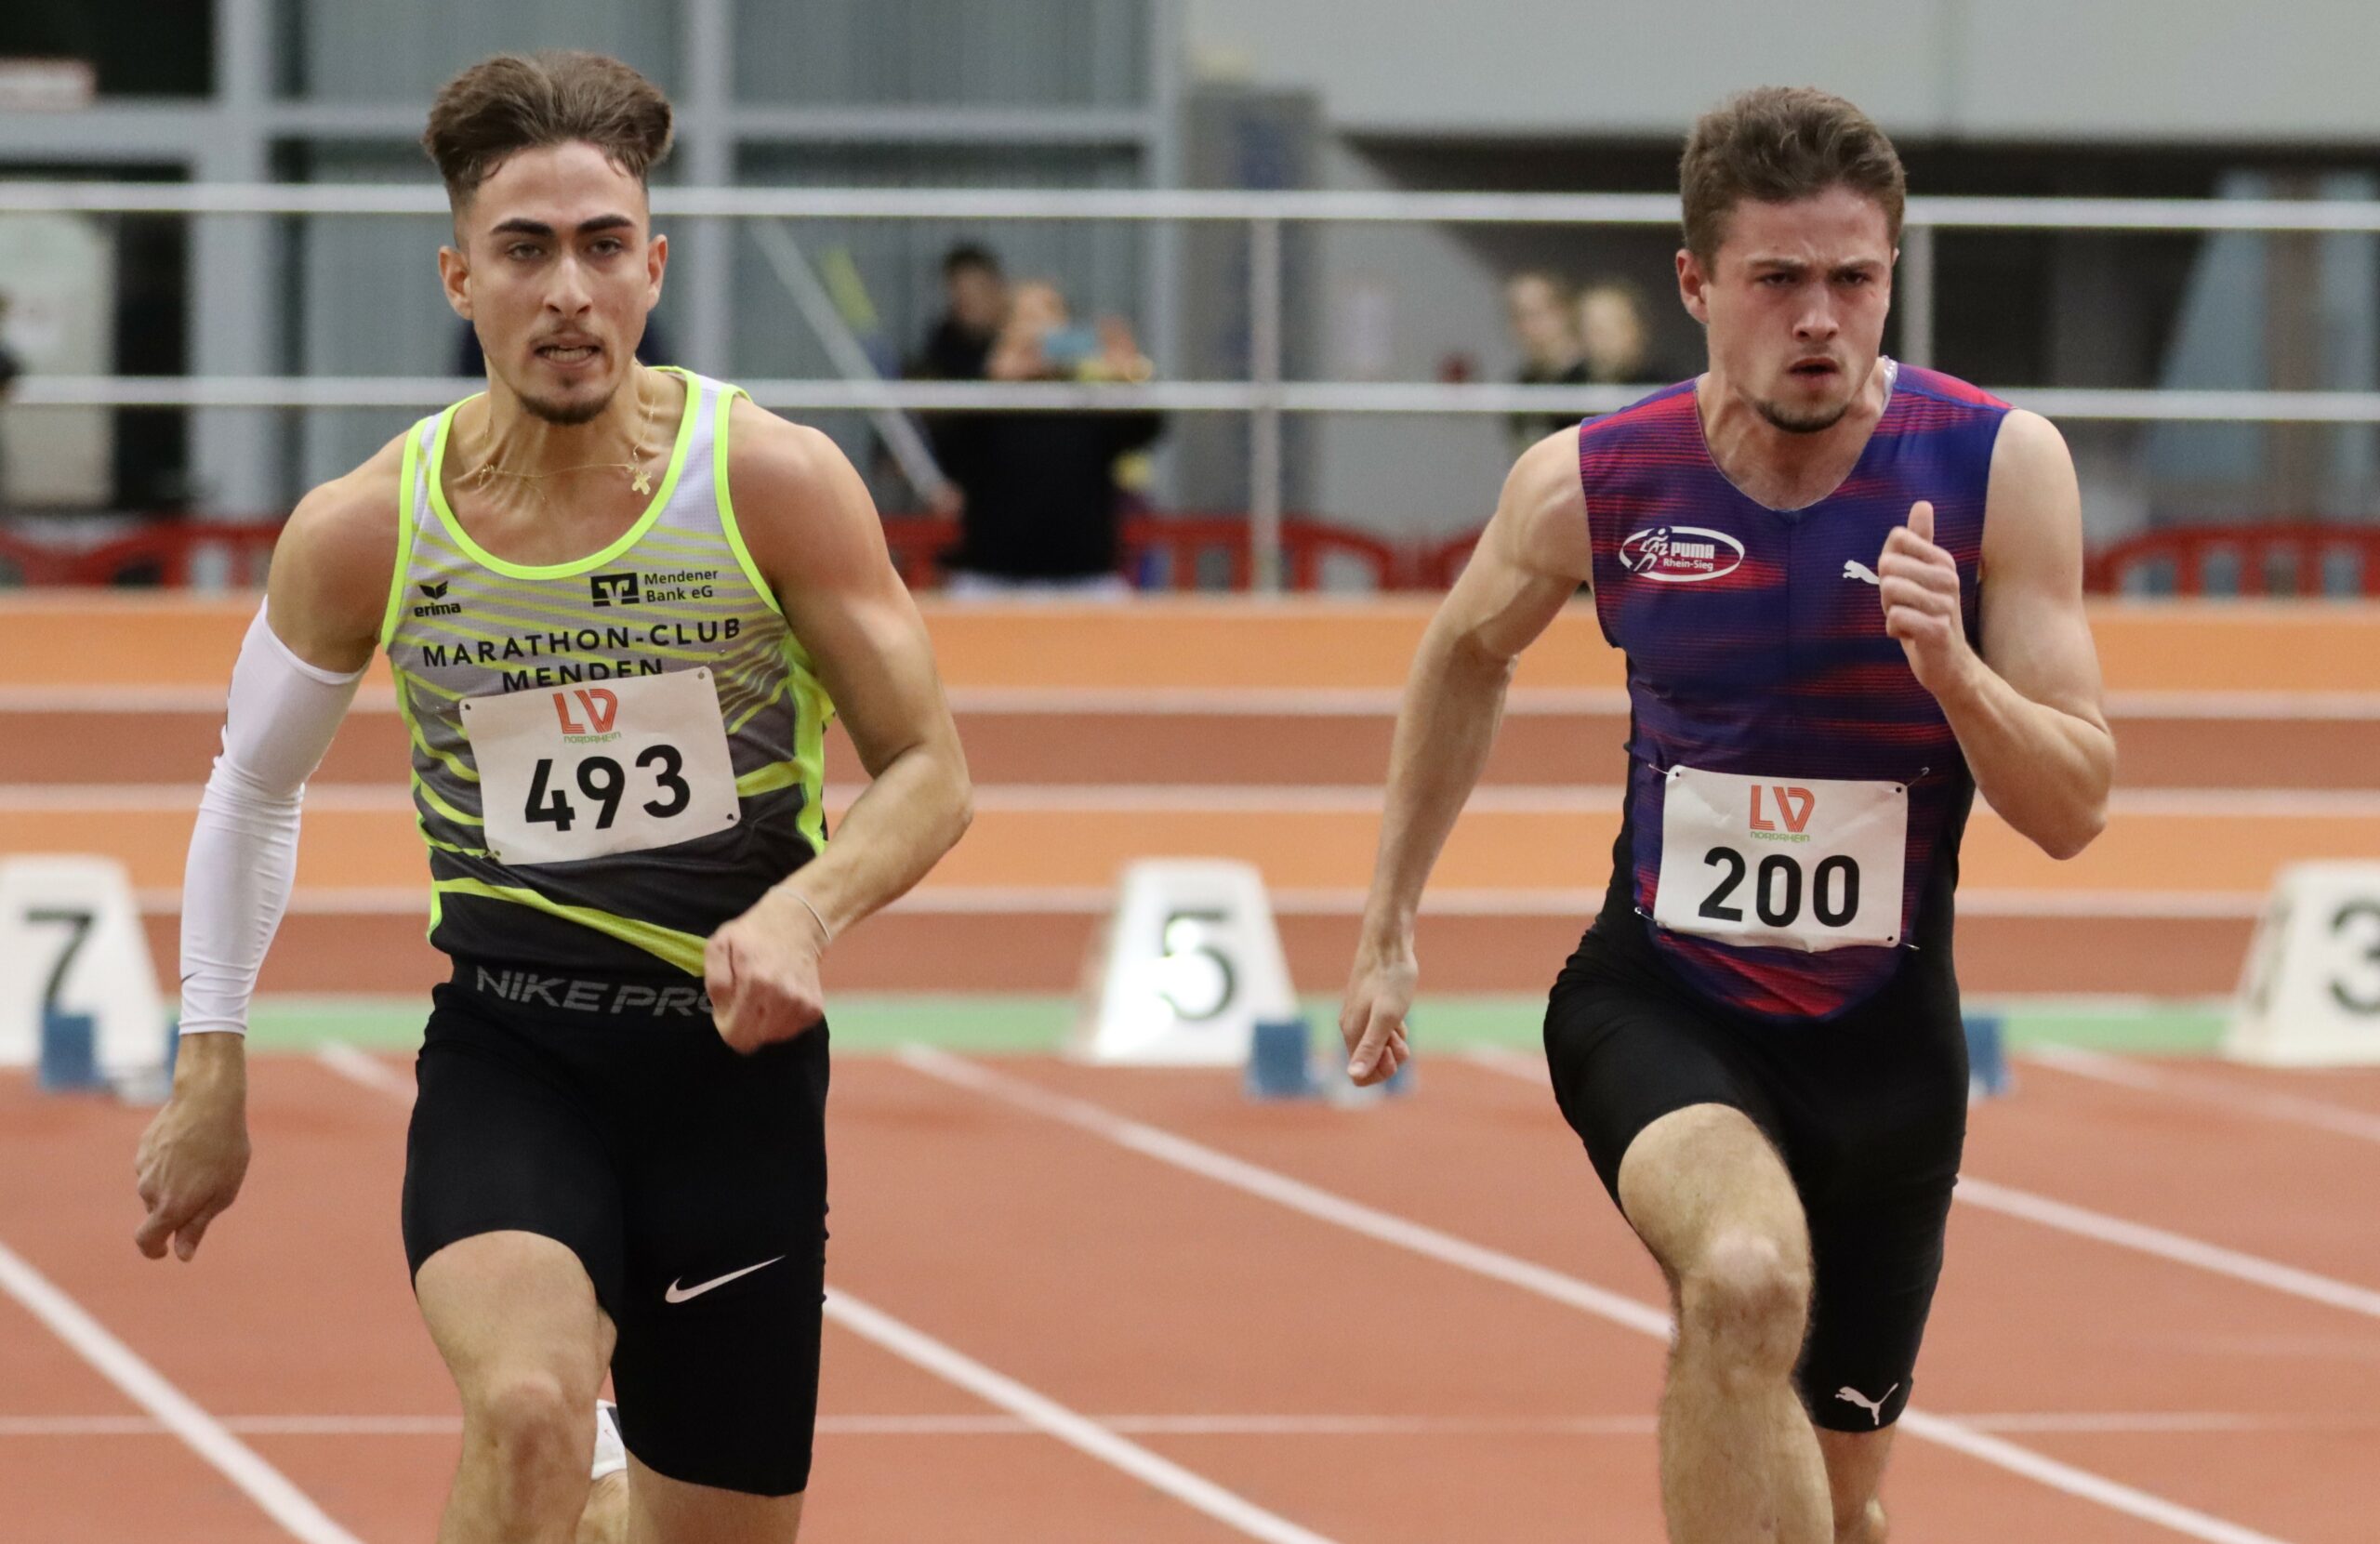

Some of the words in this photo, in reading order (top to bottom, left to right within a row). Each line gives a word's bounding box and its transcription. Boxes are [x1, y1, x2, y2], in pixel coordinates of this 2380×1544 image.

[643, 569, 719, 586] Mendener
[1662, 558, 1713, 572] Rhein-Sieg
[414, 601, 461, 618] erima
[645, 587, 686, 603] Bank
[691, 585, 714, 600] eG
[422, 617, 741, 668] MARATHON-CLUB
[502, 658, 663, 693] MENDEN
[524, 744, 691, 832] 493
[1698, 846, 1860, 928] 200
[24, 908, 94, 1010] 7
[1162, 909, 1236, 1023] 5
[2328, 900, 2380, 1017] 3
[476, 965, 609, 1011] NIKE
